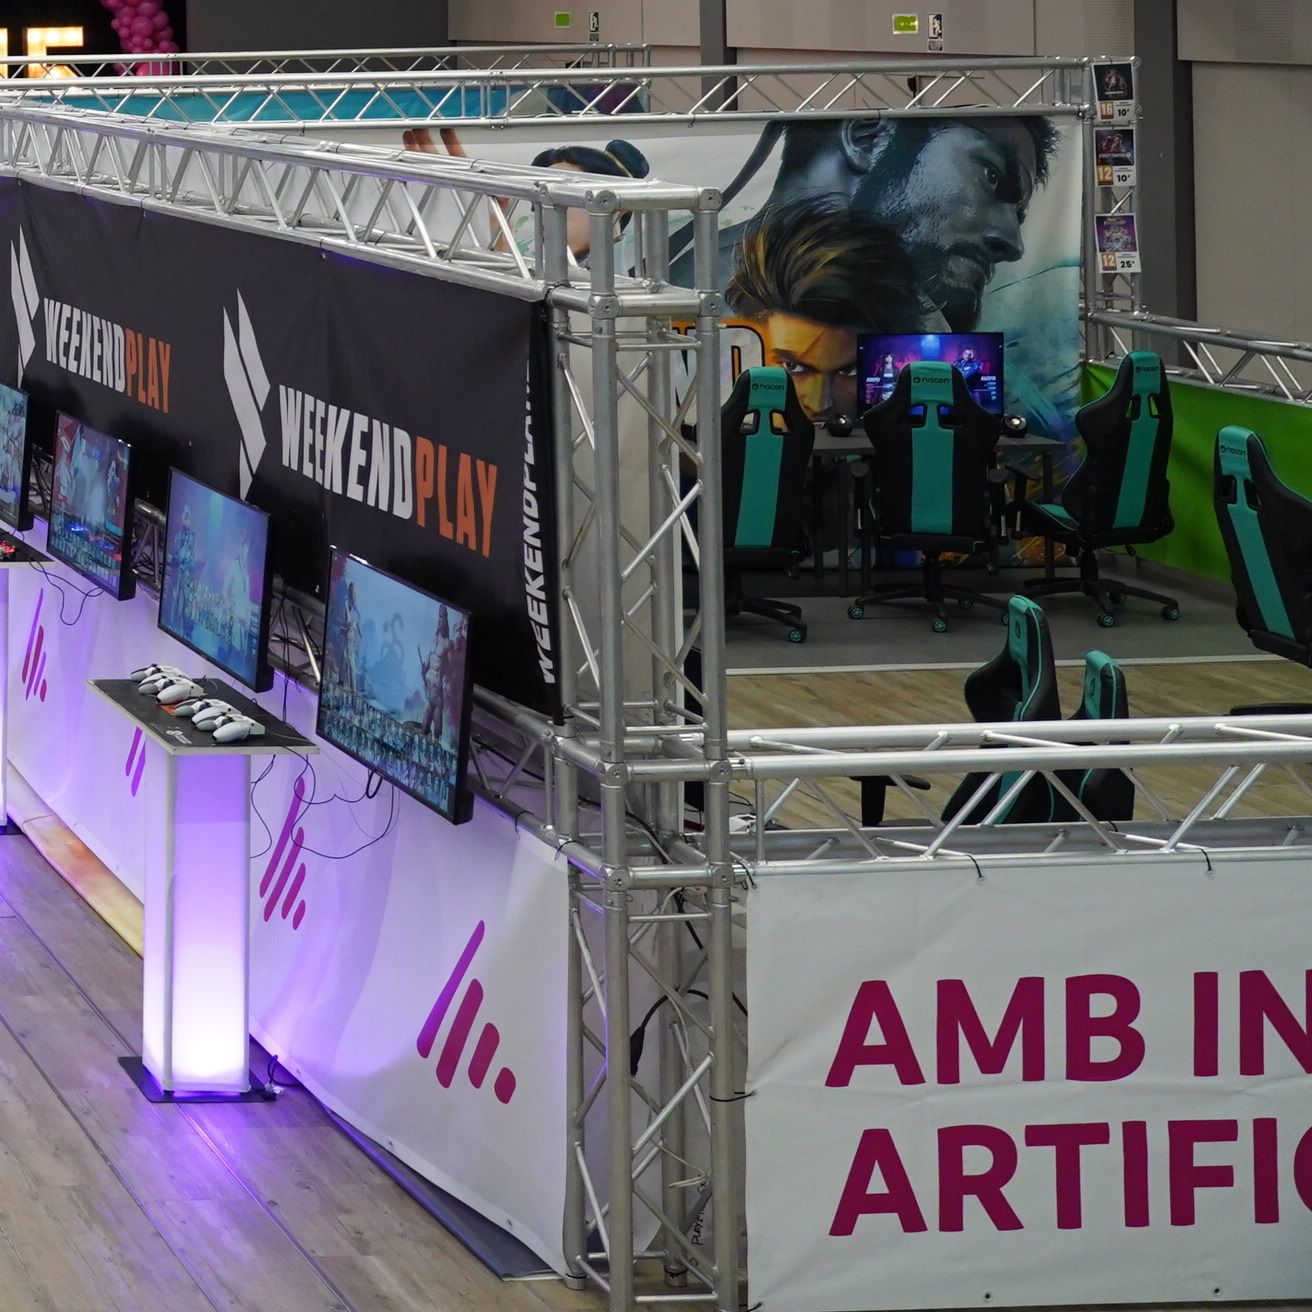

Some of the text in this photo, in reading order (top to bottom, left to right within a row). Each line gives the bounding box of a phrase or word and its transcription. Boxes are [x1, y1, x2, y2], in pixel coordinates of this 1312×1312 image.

[1101, 103, 1113, 113] 16
[1098, 167, 1112, 180] 12
[1103, 255, 1115, 266] 12
[43, 297, 171, 413] WEEKENDPLAY
[759, 383, 785, 391] nacon
[279, 383, 499, 559] WEEKENDPLAY
[823, 972, 1146, 1088] AMB
[828, 1115, 1312, 1237] ARTIFI
